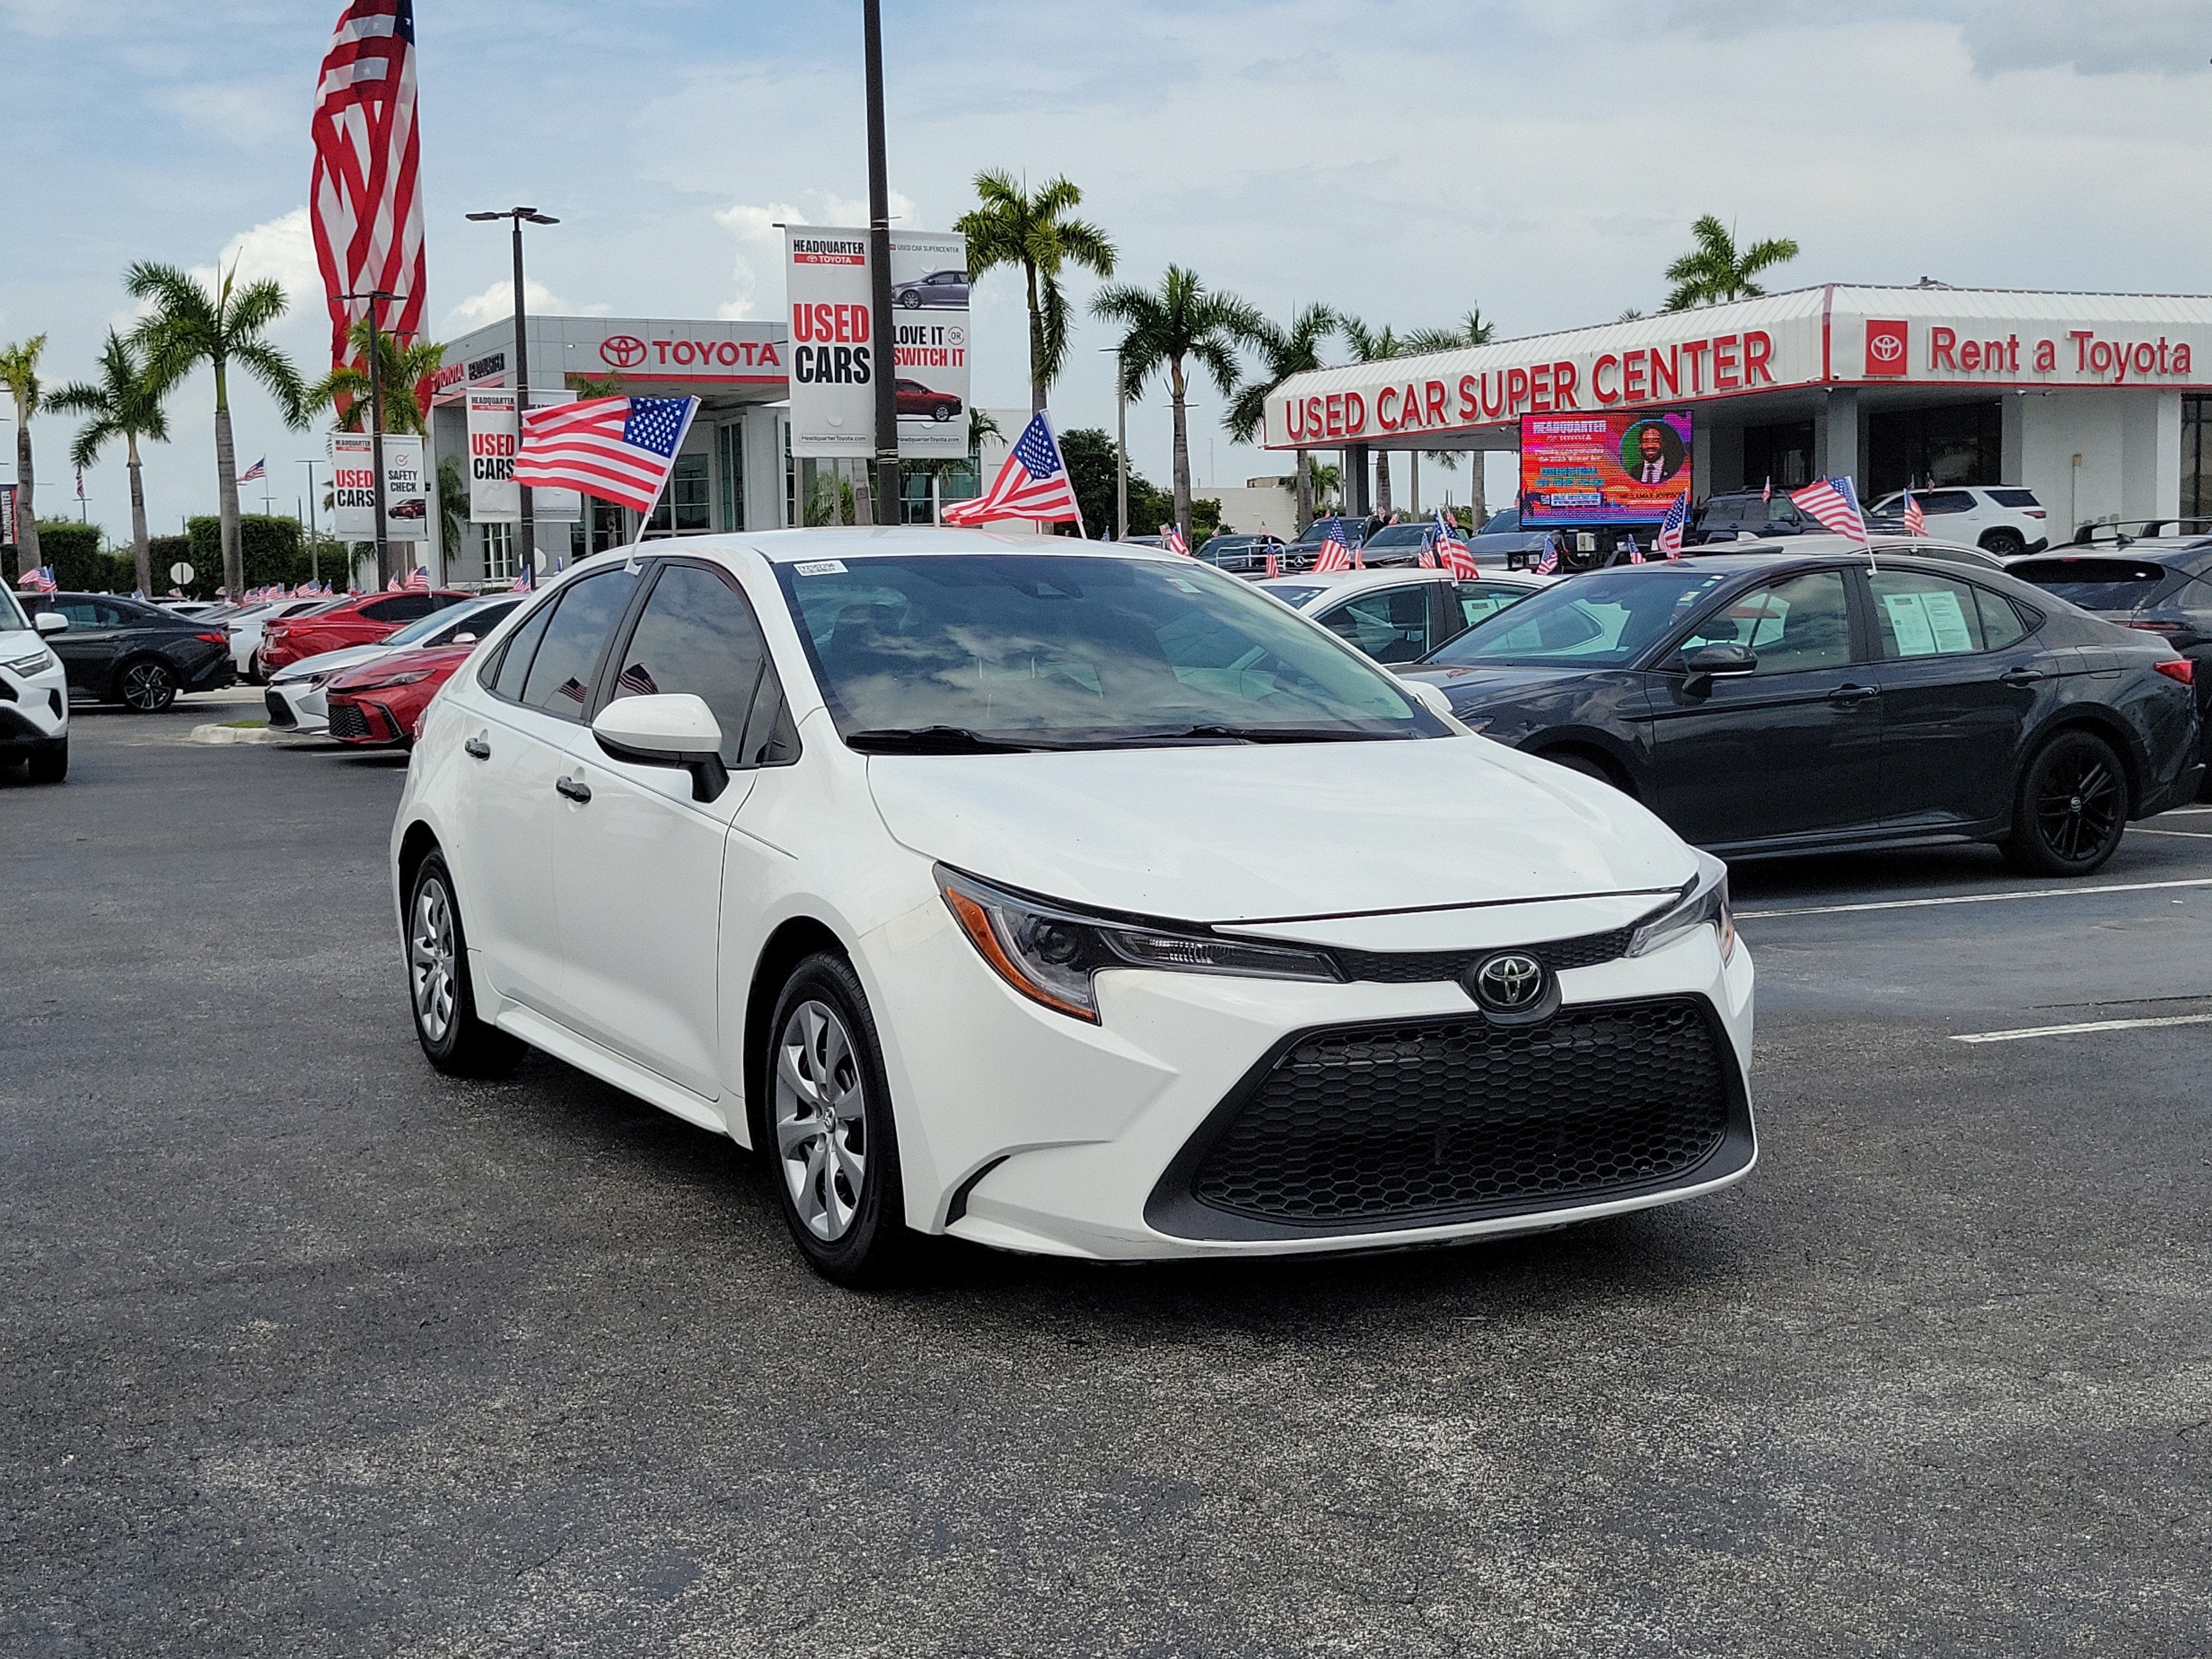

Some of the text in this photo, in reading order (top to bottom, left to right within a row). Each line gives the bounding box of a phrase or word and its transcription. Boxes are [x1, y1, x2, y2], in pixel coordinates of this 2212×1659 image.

[793, 239, 865, 255] HEADQUARTER
[819, 256, 853, 264] TOYOTA
[793, 303, 869, 343] USED
[893, 325, 961, 345] LOVE IT OR
[653, 340, 780, 366] TOYOTA
[893, 347, 966, 367] SWITCH IT
[1930, 326, 2192, 383] Rent a Toyota
[795, 346, 871, 384] CARS
[1285, 330, 1775, 441] USED CAR SUPER CENTER
[471, 397, 515, 405] HEADQUARTER
[472, 433, 515, 456] USED
[336, 470, 374, 488] USED
[388, 470, 418, 480] SAFETY
[473, 458, 515, 480] CARS
[390, 482, 417, 493] CHECK
[337, 489, 375, 507] CARS
